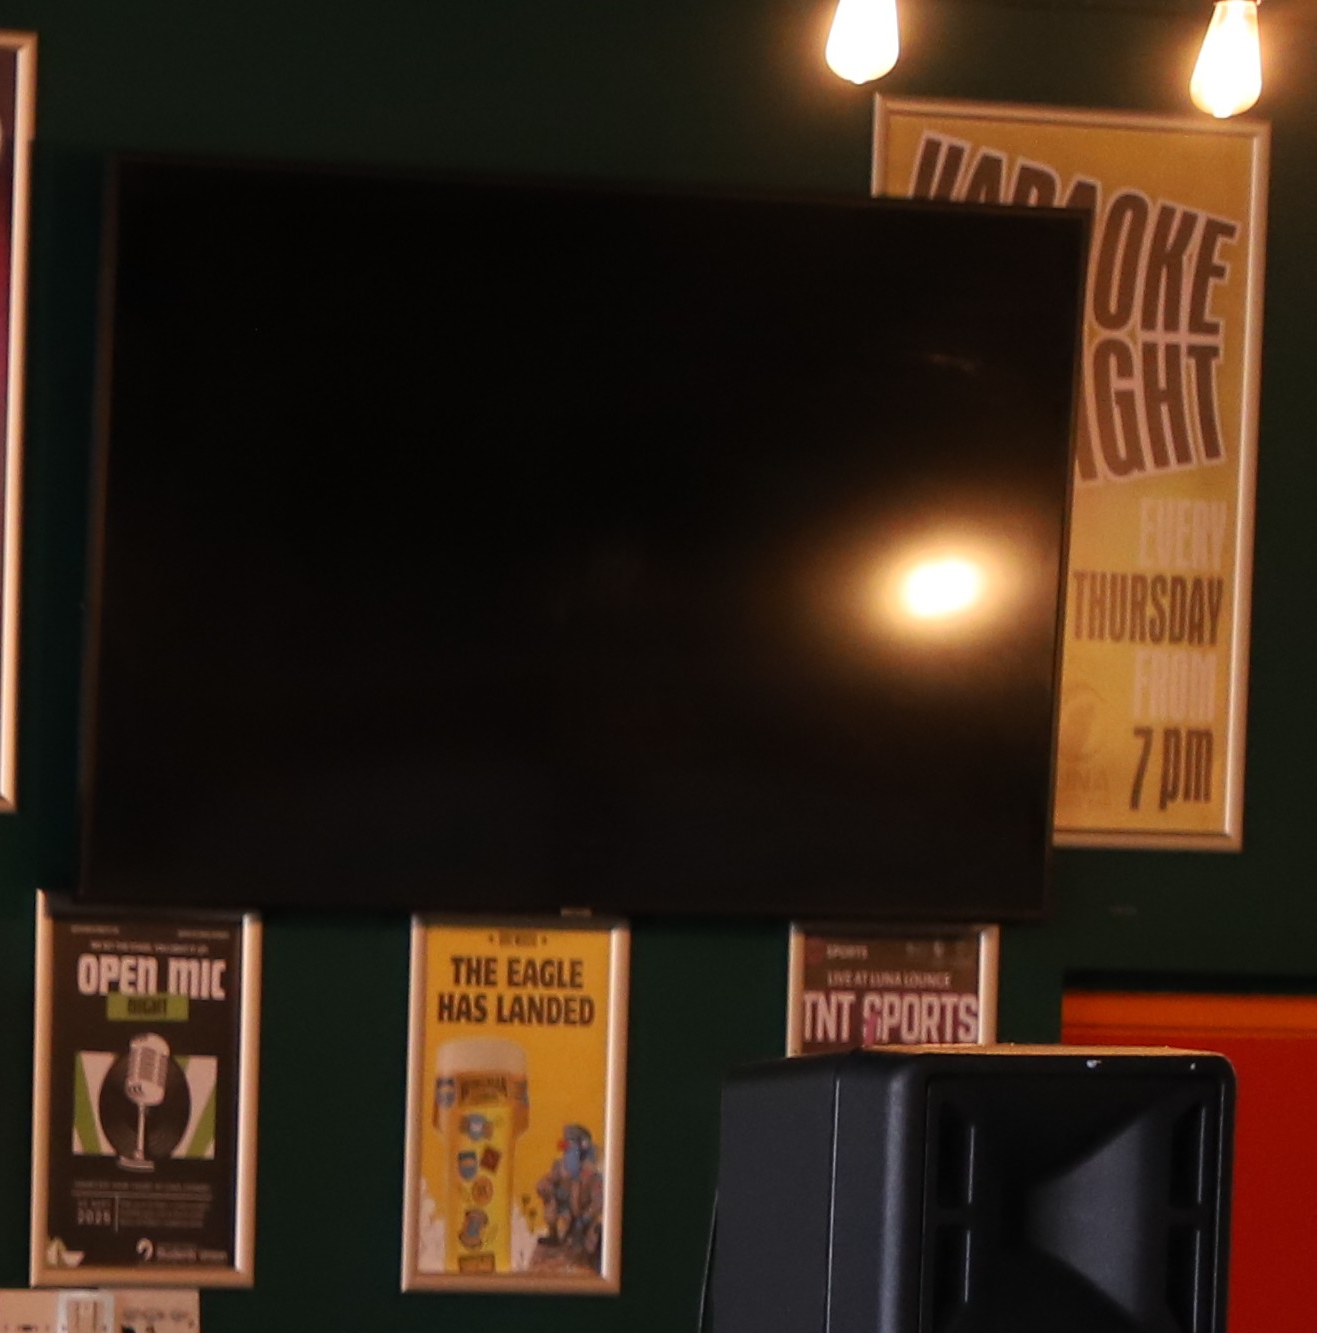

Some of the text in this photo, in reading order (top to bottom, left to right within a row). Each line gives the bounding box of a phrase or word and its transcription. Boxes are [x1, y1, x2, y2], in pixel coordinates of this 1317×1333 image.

[1074, 335, 1229, 486] GHT
[1072, 570, 1226, 647] THURSDAY
[77, 953, 227, 1001] OPEN MIC
[451, 956, 584, 990] THE EAGLE
[870, 972, 902, 987] LUNA
[437, 993, 597, 1027] HAS LANDED
[804, 992, 979, 1045] TNT SPORTS
